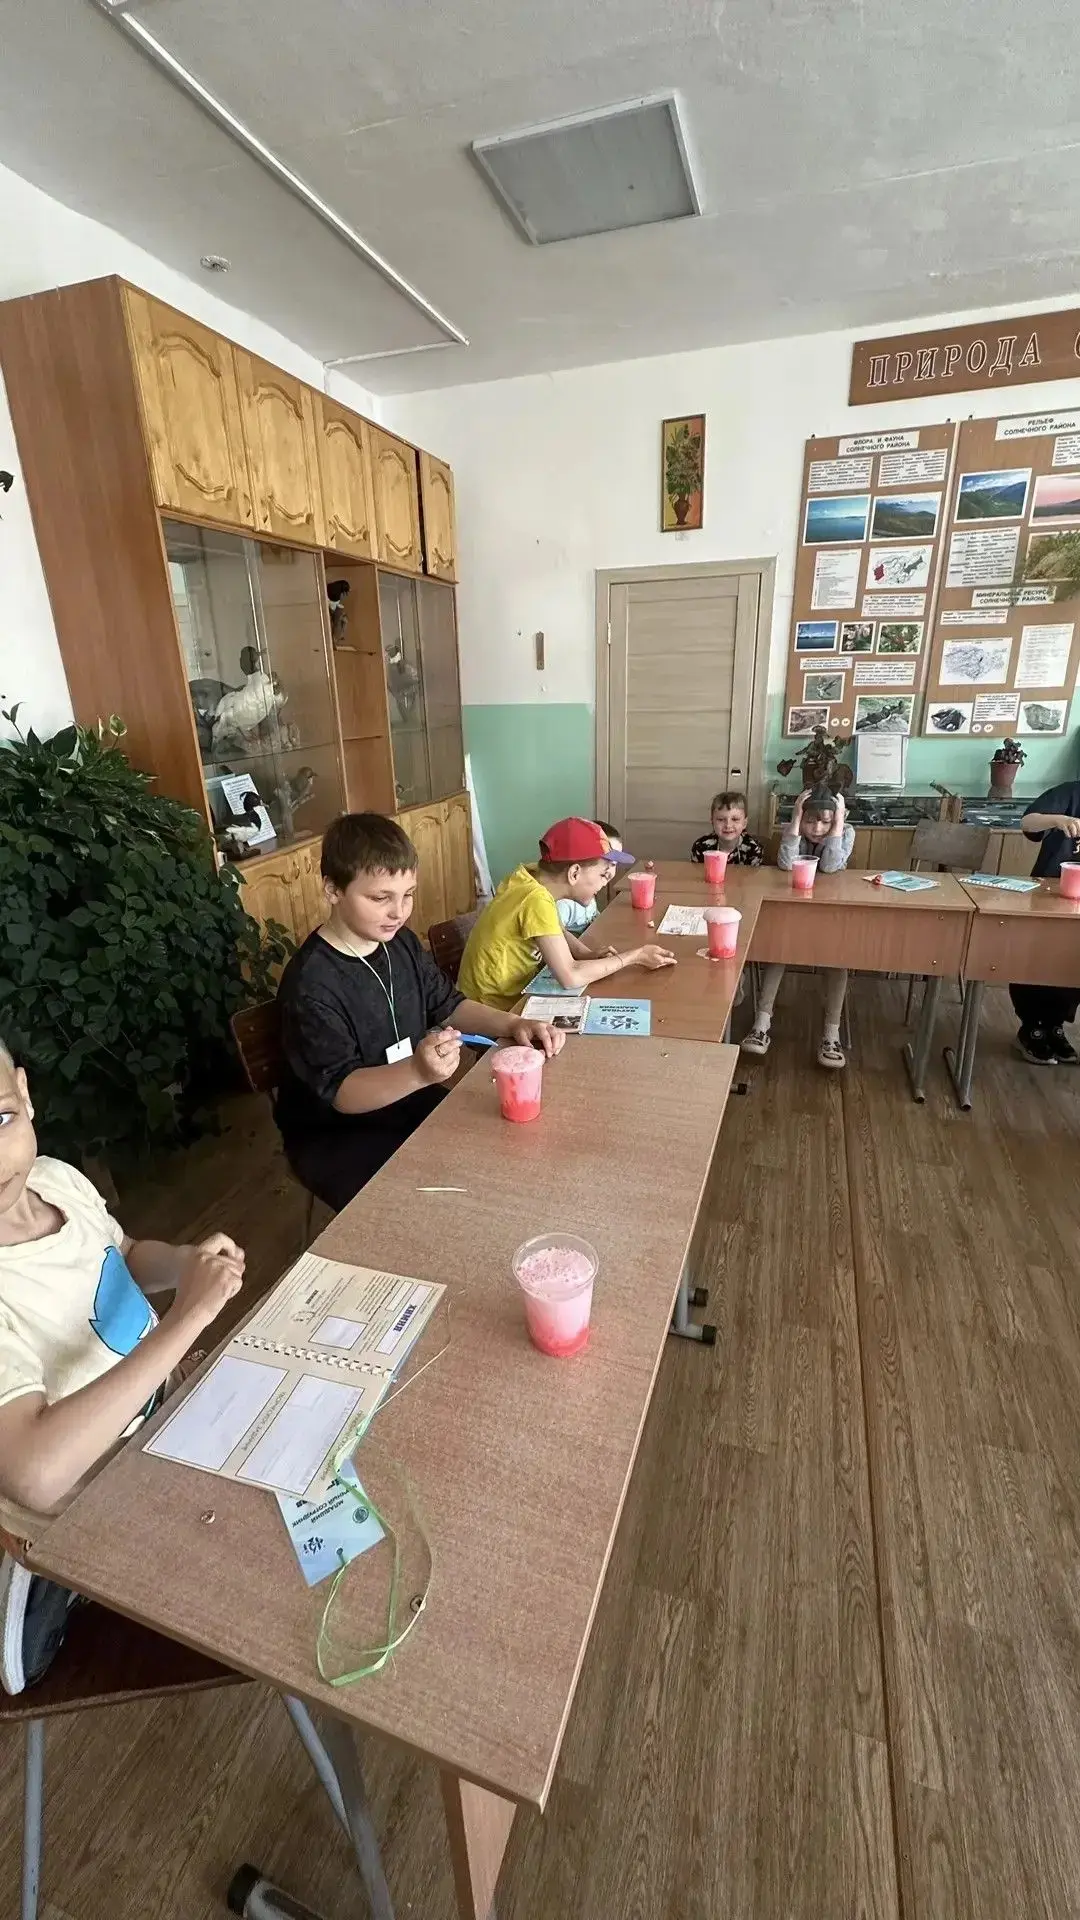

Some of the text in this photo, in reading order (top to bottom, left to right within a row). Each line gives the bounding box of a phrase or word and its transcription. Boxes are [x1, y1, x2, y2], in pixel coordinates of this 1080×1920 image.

[867, 332, 1041, 387] ПРИРОДА
[1004, 422, 1076, 436] СОЛНЕЧНОГО РАЙОНА
[1027, 418, 1054, 426] РЕЛЬЕФ
[884, 434, 904, 442] ФАУНА
[846, 443, 884, 453] СОЛНЕЧНОГО
[393, 1303, 418, 1333] ХИМИЯ
[292, 1502, 328, 1528] СОТРУДНИК
[310, 1499, 344, 1524] МЛАДШИЙ
